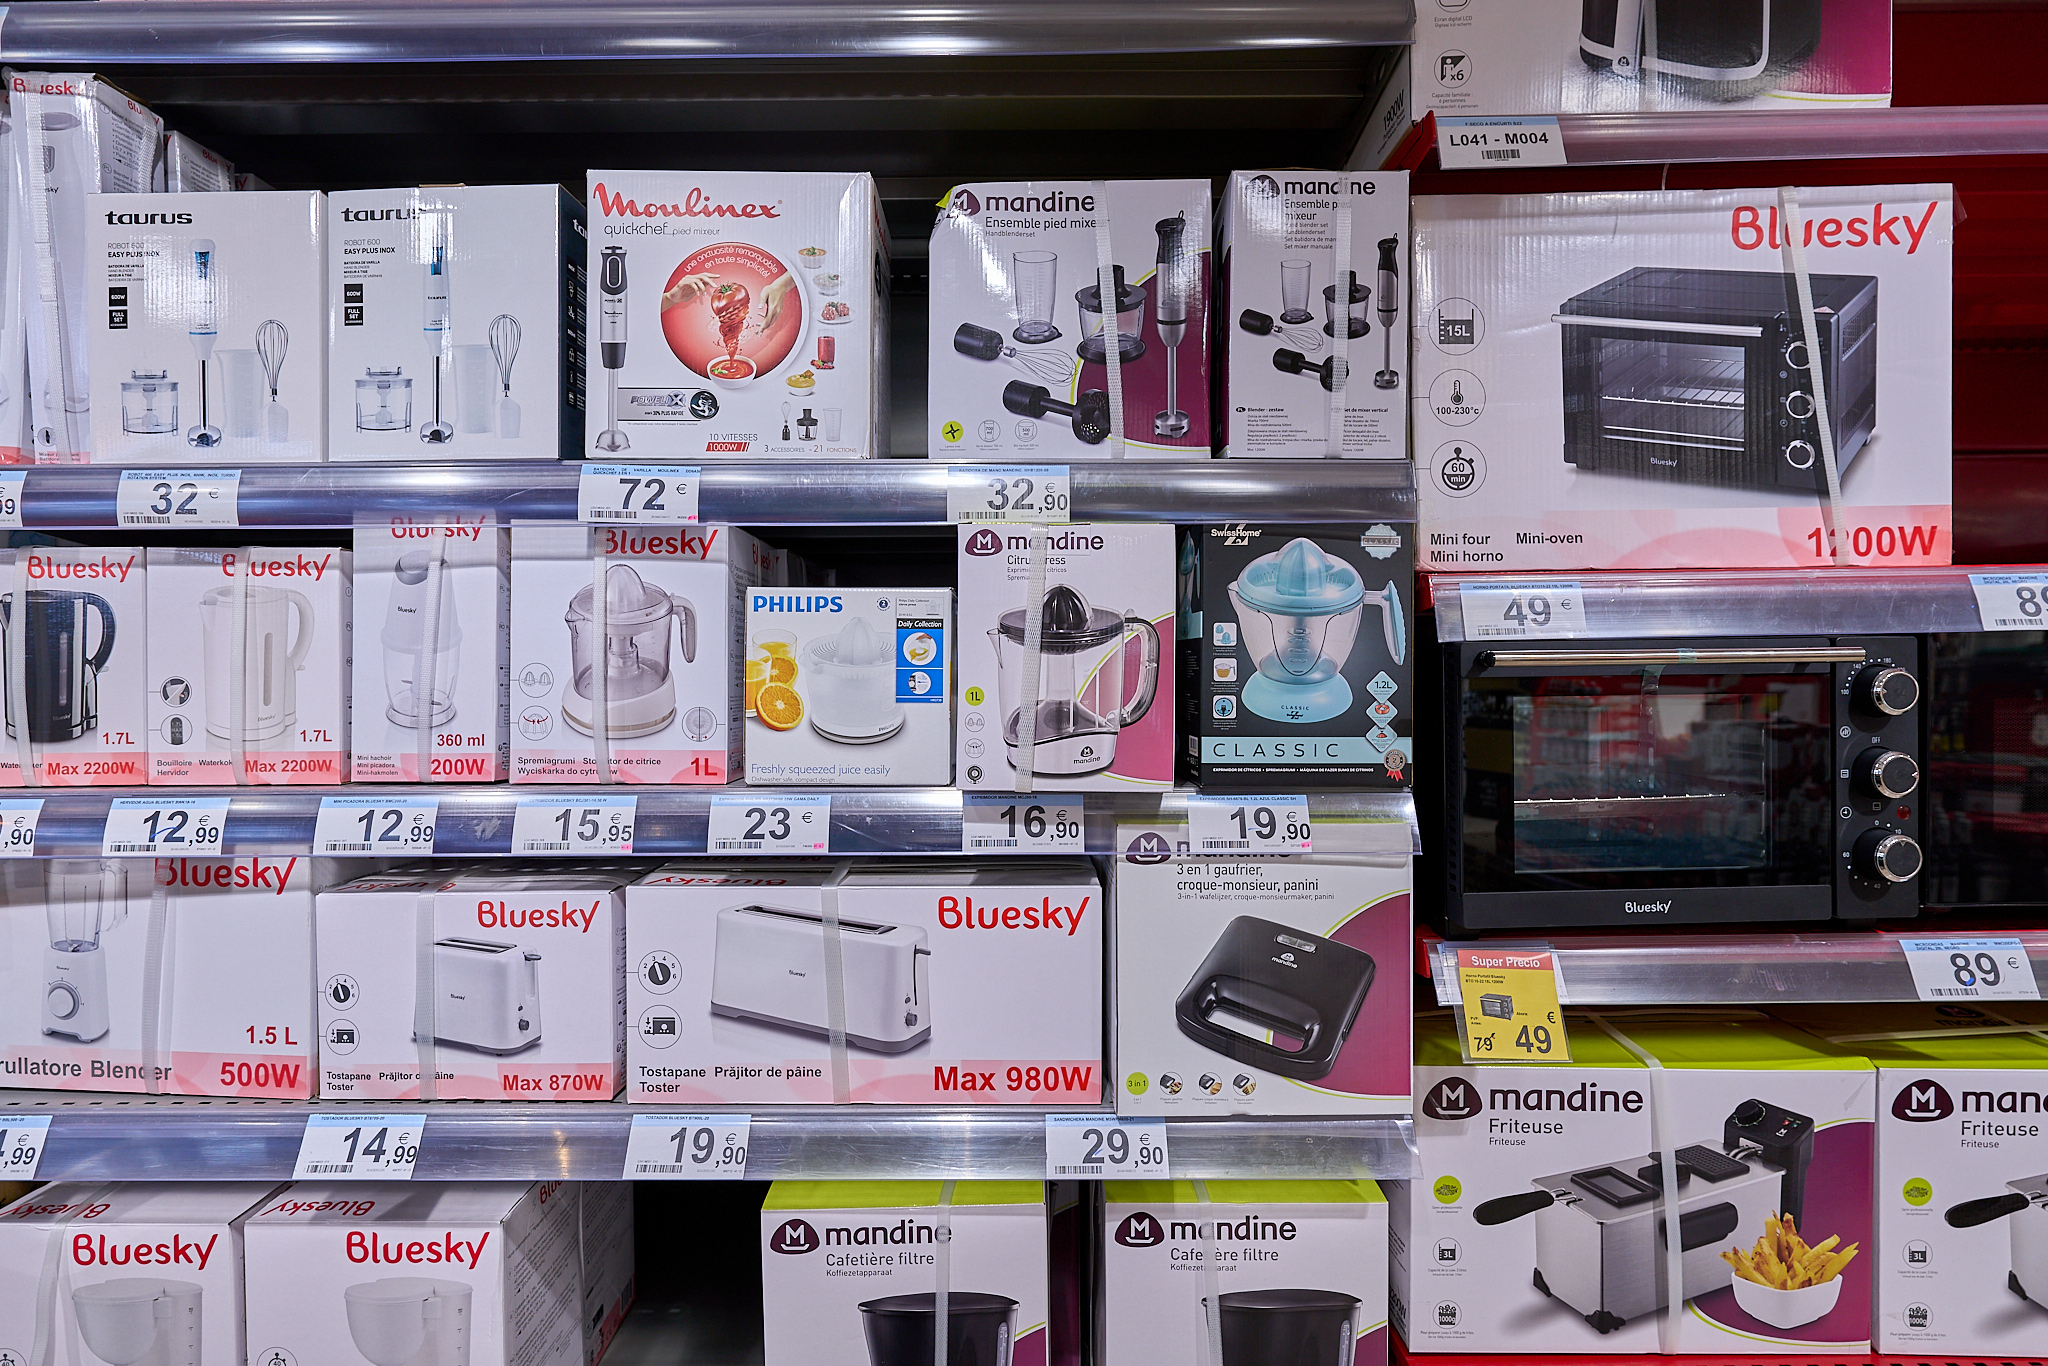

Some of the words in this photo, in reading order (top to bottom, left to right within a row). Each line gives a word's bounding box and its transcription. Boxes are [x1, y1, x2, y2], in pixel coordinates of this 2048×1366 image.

[1450, 134, 1488, 147] L041
[1505, 132, 1549, 144] M004
[593, 182, 781, 219] Moulinex
[986, 191, 1096, 213] mandine
[1285, 199, 1330, 209] Ensemble
[104, 211, 193, 225] taurus
[986, 217, 1041, 229] Ensemble
[1044, 217, 1068, 231] pied
[986, 230, 1036, 238] Handblenderset
[715, 256, 736, 265] toute
[736, 248, 779, 274] remarquable
[1447, 325, 1471, 337] 15L
[721, 434, 758, 442] VITESSES
[1451, 463, 1465, 473] 60
[1650, 456, 1678, 468] Bluesky
[1451, 475, 1466, 483] min
[150, 483, 198, 515] 32
[209, 488, 220, 499] €
[620, 478, 666, 510] 72
[676, 484, 688, 495] €
[987, 478, 1068, 514] 32,90
[1430, 532, 1458, 546] Mini
[1462, 531, 1491, 546] four
[1516, 532, 1584, 545] Mini-oven
[1430, 550, 1458, 564] Mini
[1462, 549, 1504, 564] horno
[27, 556, 136, 583] Bluesky
[398, 606, 417, 614] Bluesky
[753, 596, 843, 613] PHILIPS
[1503, 595, 1551, 627] 49
[898, 620, 913, 628] Daily
[914, 620, 942, 628] Collection
[1375, 681, 1393, 689] 1.2L
[970, 692, 981, 701] 1L
[102, 733, 135, 746] 1.7L
[300, 730, 333, 743] 1.7L
[437, 735, 463, 746] 360
[467, 734, 485, 746] ml
[1213, 744, 1339, 758] CLASSIC
[245, 760, 273, 773] Max
[281, 759, 333, 772] 2200W
[431, 758, 486, 776] 200W
[518, 757, 576, 766] Spremiagrumi
[624, 757, 634, 765] de
[636, 757, 662, 765] citrice
[690, 757, 718, 776] 1L
[1074, 755, 1101, 764] mandine
[48, 763, 81, 776] Max
[84, 762, 136, 775] 2200W
[518, 767, 565, 776] Wyciskarka
[751, 764, 786, 776] Freshly
[789, 765, 836, 776] squeezed
[838, 764, 861, 776] juice
[864, 764, 891, 776] easily
[143, 810, 219, 847] 12,99
[358, 809, 434, 846] 12,99
[555, 809, 632, 845] 15,95
[743, 808, 791, 840] 23
[802, 812, 813, 824] €
[1000, 805, 1079, 842] 16,90
[1230, 807, 1311, 844] 19,90
[155, 857, 298, 895] Bluesky
[1177, 864, 1184, 876] 3
[1186, 867, 1201, 876] en
[1214, 864, 1263, 878] gaufrier,
[1177, 880, 1281, 894] croque-monsieur,
[1284, 880, 1319, 894] panini
[1199, 893, 1233, 901] wafelijzer,
[1234, 893, 1314, 902] croque-monsieurmaker,
[1315, 893, 1335, 901] panini
[1625, 900, 1672, 914] Bluesky
[477, 900, 600, 934] Bluesky
[938, 896, 1090, 937] Bluesky
[1272, 956, 1298, 969] mandine
[1471, 956, 1503, 968] Super
[1506, 957, 1540, 968] Precio
[1950, 952, 2000, 987] 89
[789, 969, 807, 978] Bluesky
[1547, 1012, 1556, 1024] €
[246, 1026, 277, 1044] 1.5
[1516, 1025, 1552, 1054] 49
[220, 1062, 300, 1089] 500W
[327, 1072, 372, 1082] Tostapane
[379, 1071, 413, 1082] Prăjitor
[639, 1066, 706, 1080] Tostapane
[714, 1065, 763, 1080] Prăjitor
[766, 1066, 782, 1079] de
[786, 1066, 822, 1081] pâine
[934, 1067, 996, 1092] Max
[1006, 1066, 1092, 1092] 980W
[327, 1082, 354, 1091] Toster
[504, 1075, 542, 1091] Max
[549, 1074, 604, 1091] 870W
[639, 1082, 680, 1094] Toster
[1490, 1082, 1644, 1113] mandine
[1489, 1118, 1563, 1134] Friteuse
[1961, 1120, 2039, 1137] Friteuse
[344, 1127, 418, 1168] 14,99
[670, 1127, 746, 1169] 19,90
[1082, 1128, 1164, 1168] 29,90
[1489, 1138, 1526, 1146] Friteuse
[1961, 1139, 2000, 1149] Friteuse
[825, 1219, 952, 1246] mandine
[72, 1234, 218, 1270] Bluesky
[346, 1231, 490, 1270] Bluesky
[1243, 1247, 1279, 1261] filtre
[826, 1252, 894, 1267] Cafetière
[898, 1252, 934, 1266] filtre
[826, 1269, 893, 1278] Koffiezetapparaat
